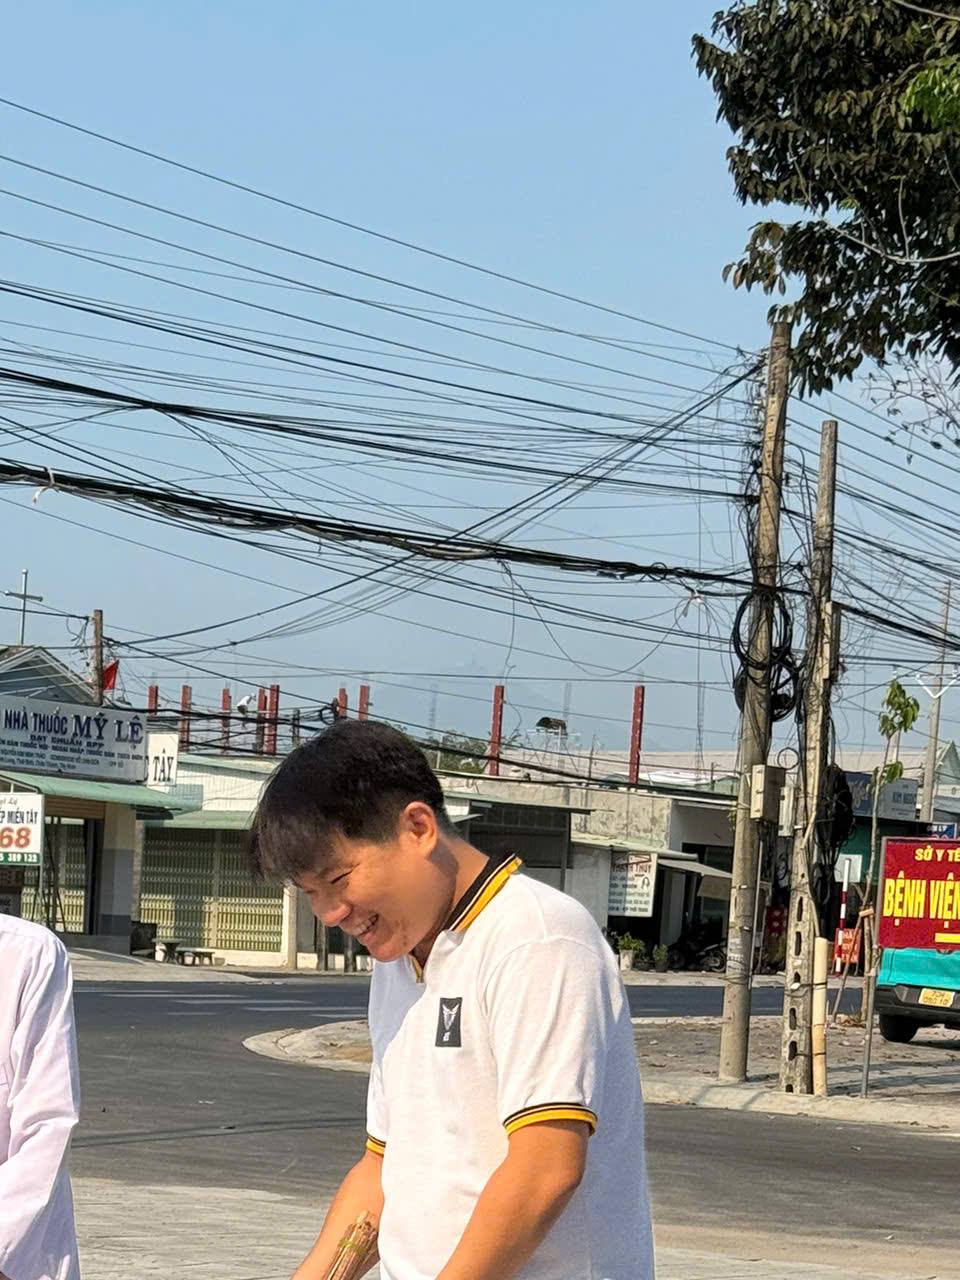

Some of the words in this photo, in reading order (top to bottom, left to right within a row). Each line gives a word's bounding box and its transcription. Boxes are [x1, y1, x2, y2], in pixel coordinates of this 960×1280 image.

[4, 706, 28, 730] NHÀ
[31, 706, 68, 735] THUỐC
[114, 715, 143, 749] LỆ
[153, 748, 174, 782] TÂY
[936, 848, 945, 862] Y
[883, 870, 927, 927] BỆNH
